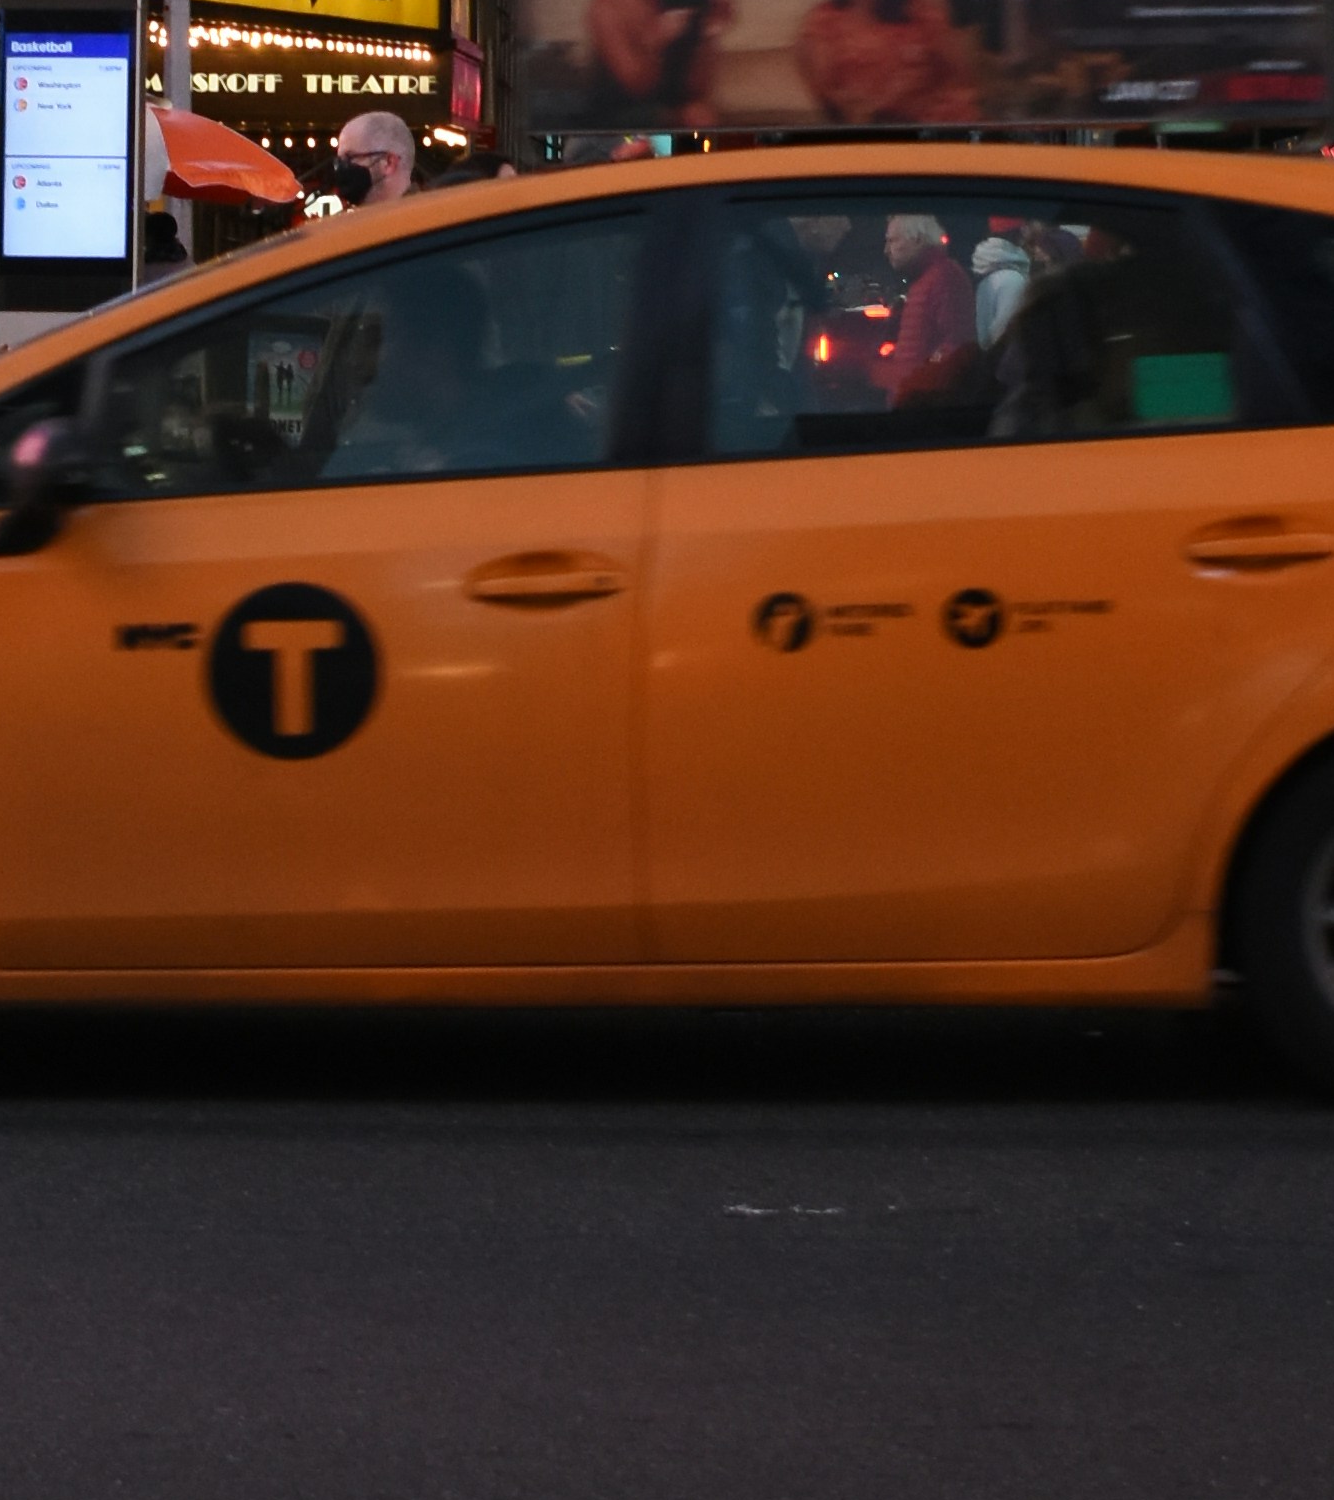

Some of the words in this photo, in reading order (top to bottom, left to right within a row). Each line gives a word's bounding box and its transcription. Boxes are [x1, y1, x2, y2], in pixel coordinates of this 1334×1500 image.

[11, 40, 73, 54] Basketball
[302, 73, 438, 95] THEATRE
[239, 619, 348, 738] T
